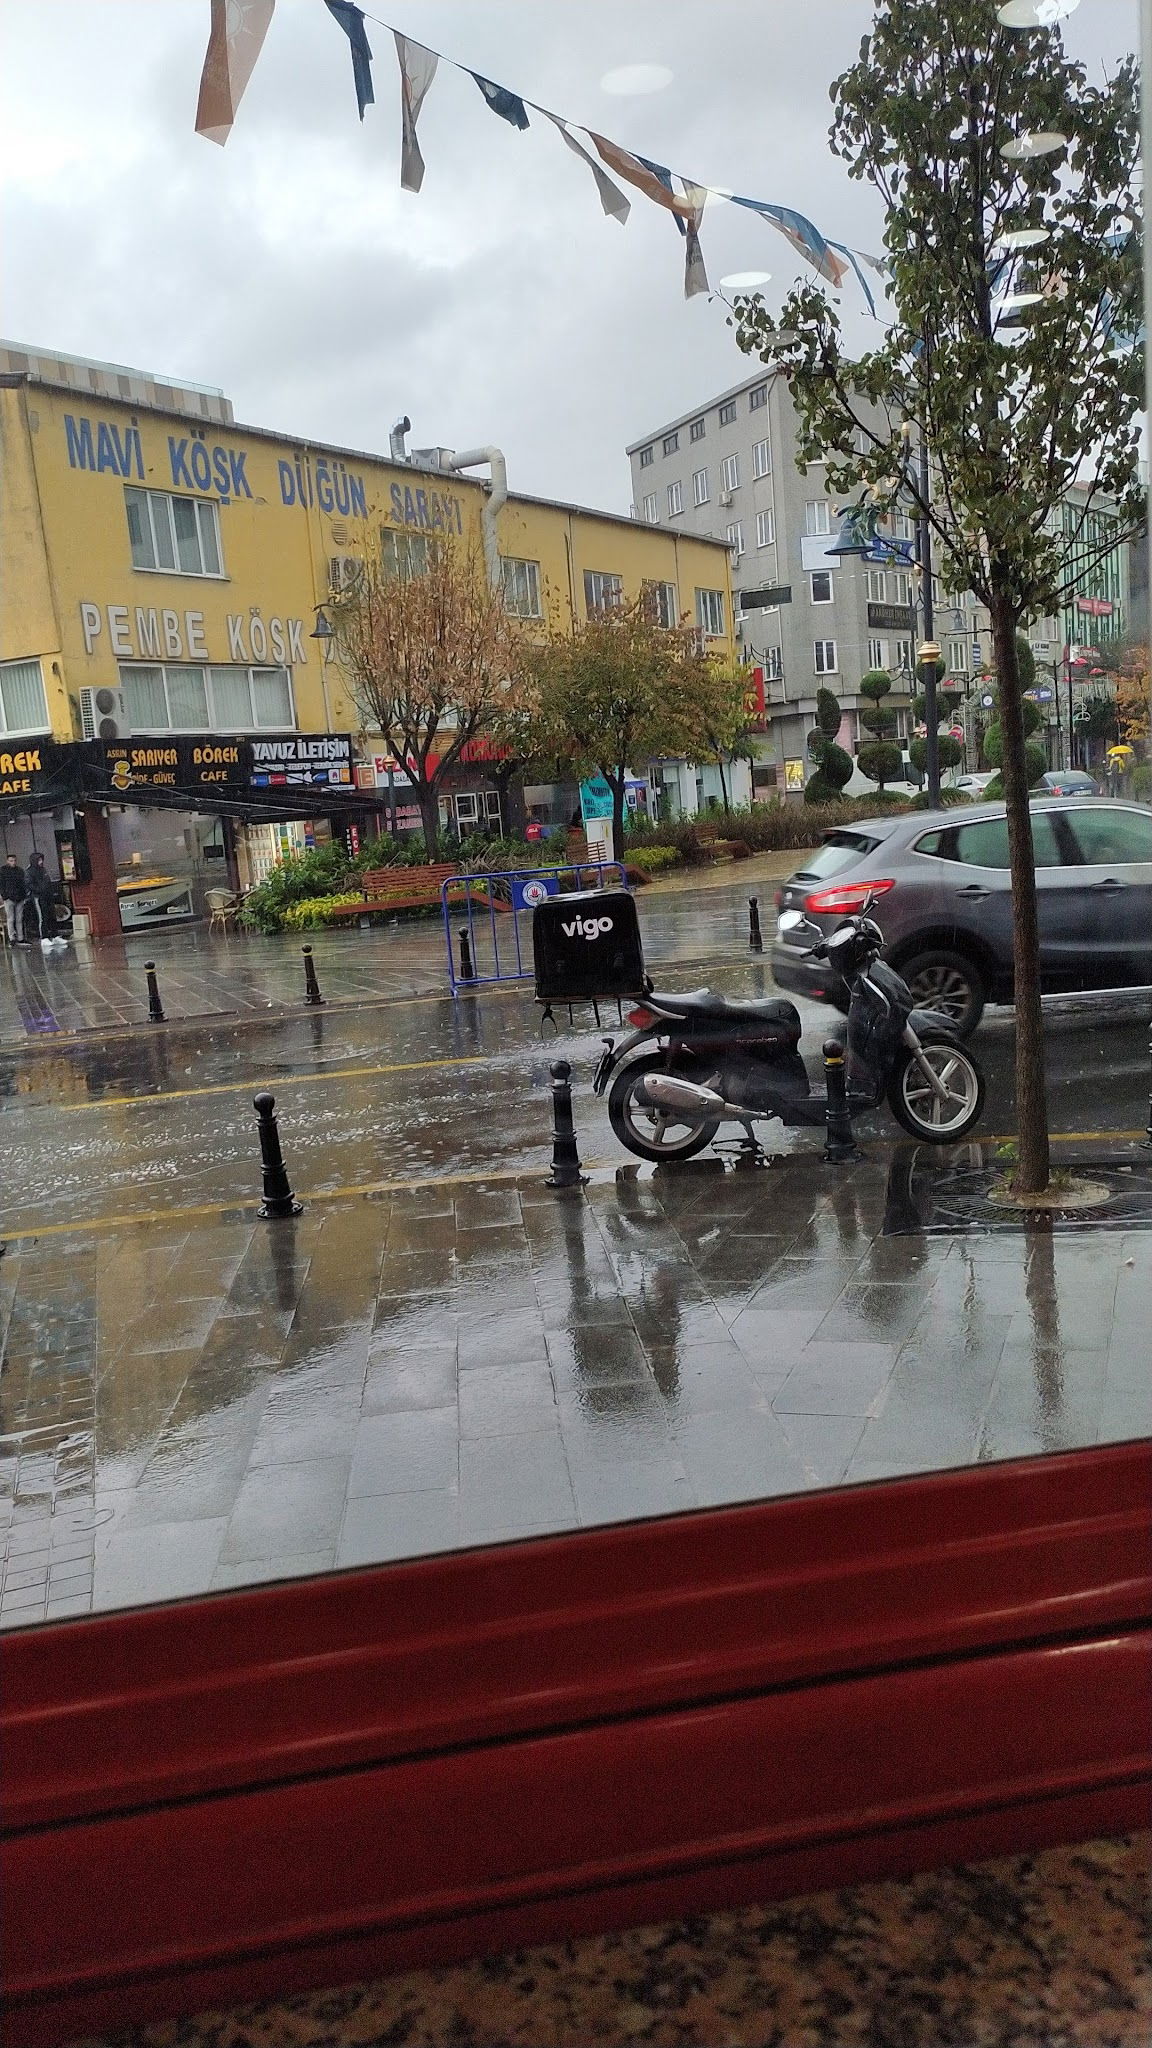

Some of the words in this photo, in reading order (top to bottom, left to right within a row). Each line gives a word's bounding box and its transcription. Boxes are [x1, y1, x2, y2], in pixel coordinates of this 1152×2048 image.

[64, 415, 145, 480] MAVİ
[168, 429, 253, 505] KÖŞK
[278, 453, 368, 519] DÜĞÜN
[80, 602, 209, 659] PEMBE
[131, 749, 178, 767] SARIYER
[193, 744, 239, 765] BÖREK
[252, 741, 296, 761] YAVUZ
[297, 738, 350, 761] İLETİŞİM
[153, 771, 176, 786] GÜVEÇ
[200, 770, 229, 782] CAFE
[561, 914, 614, 940] vigo
